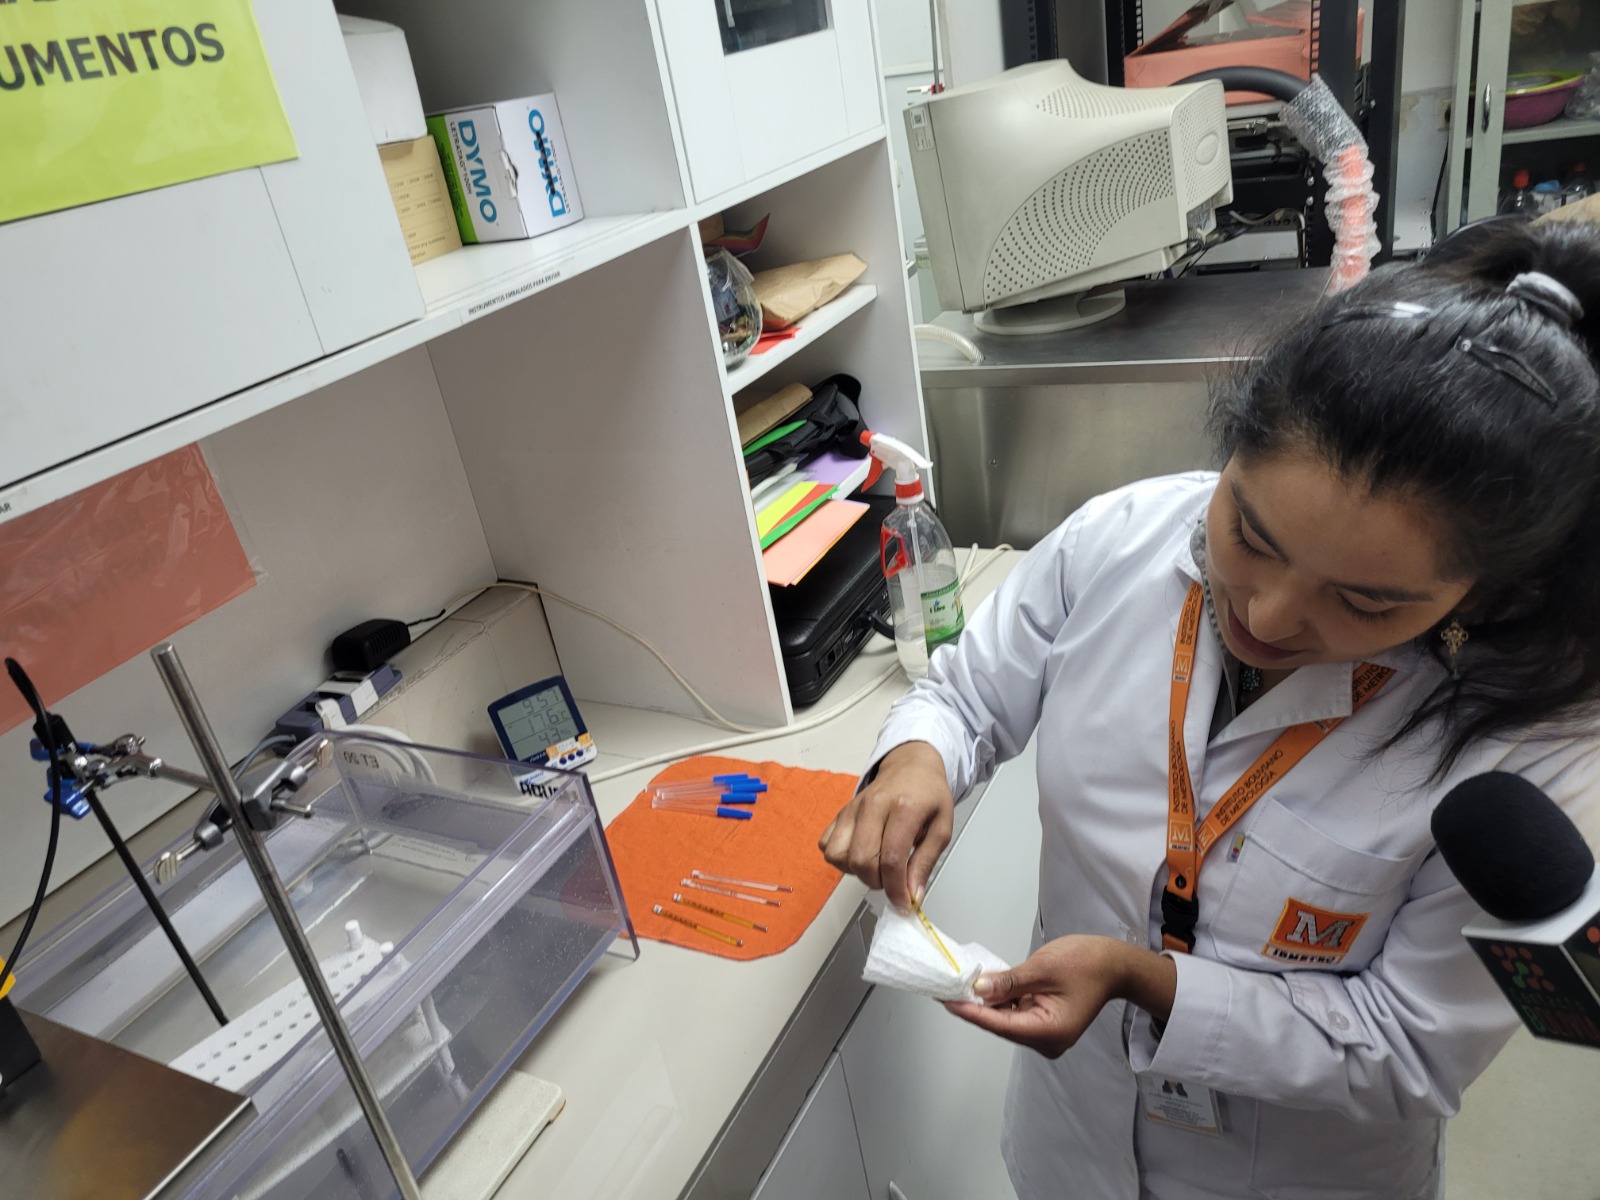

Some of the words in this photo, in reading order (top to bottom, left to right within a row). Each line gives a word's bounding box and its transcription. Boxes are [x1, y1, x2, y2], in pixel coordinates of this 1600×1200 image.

[458, 120, 497, 223] DYMO
[528, 109, 567, 218] DYMO
[1215, 788, 1245, 819] INSTITUTO
[1244, 749, 1284, 789] BOLIVIANO
[1220, 816, 1230, 827] DE
[1286, 910, 1355, 949] M
